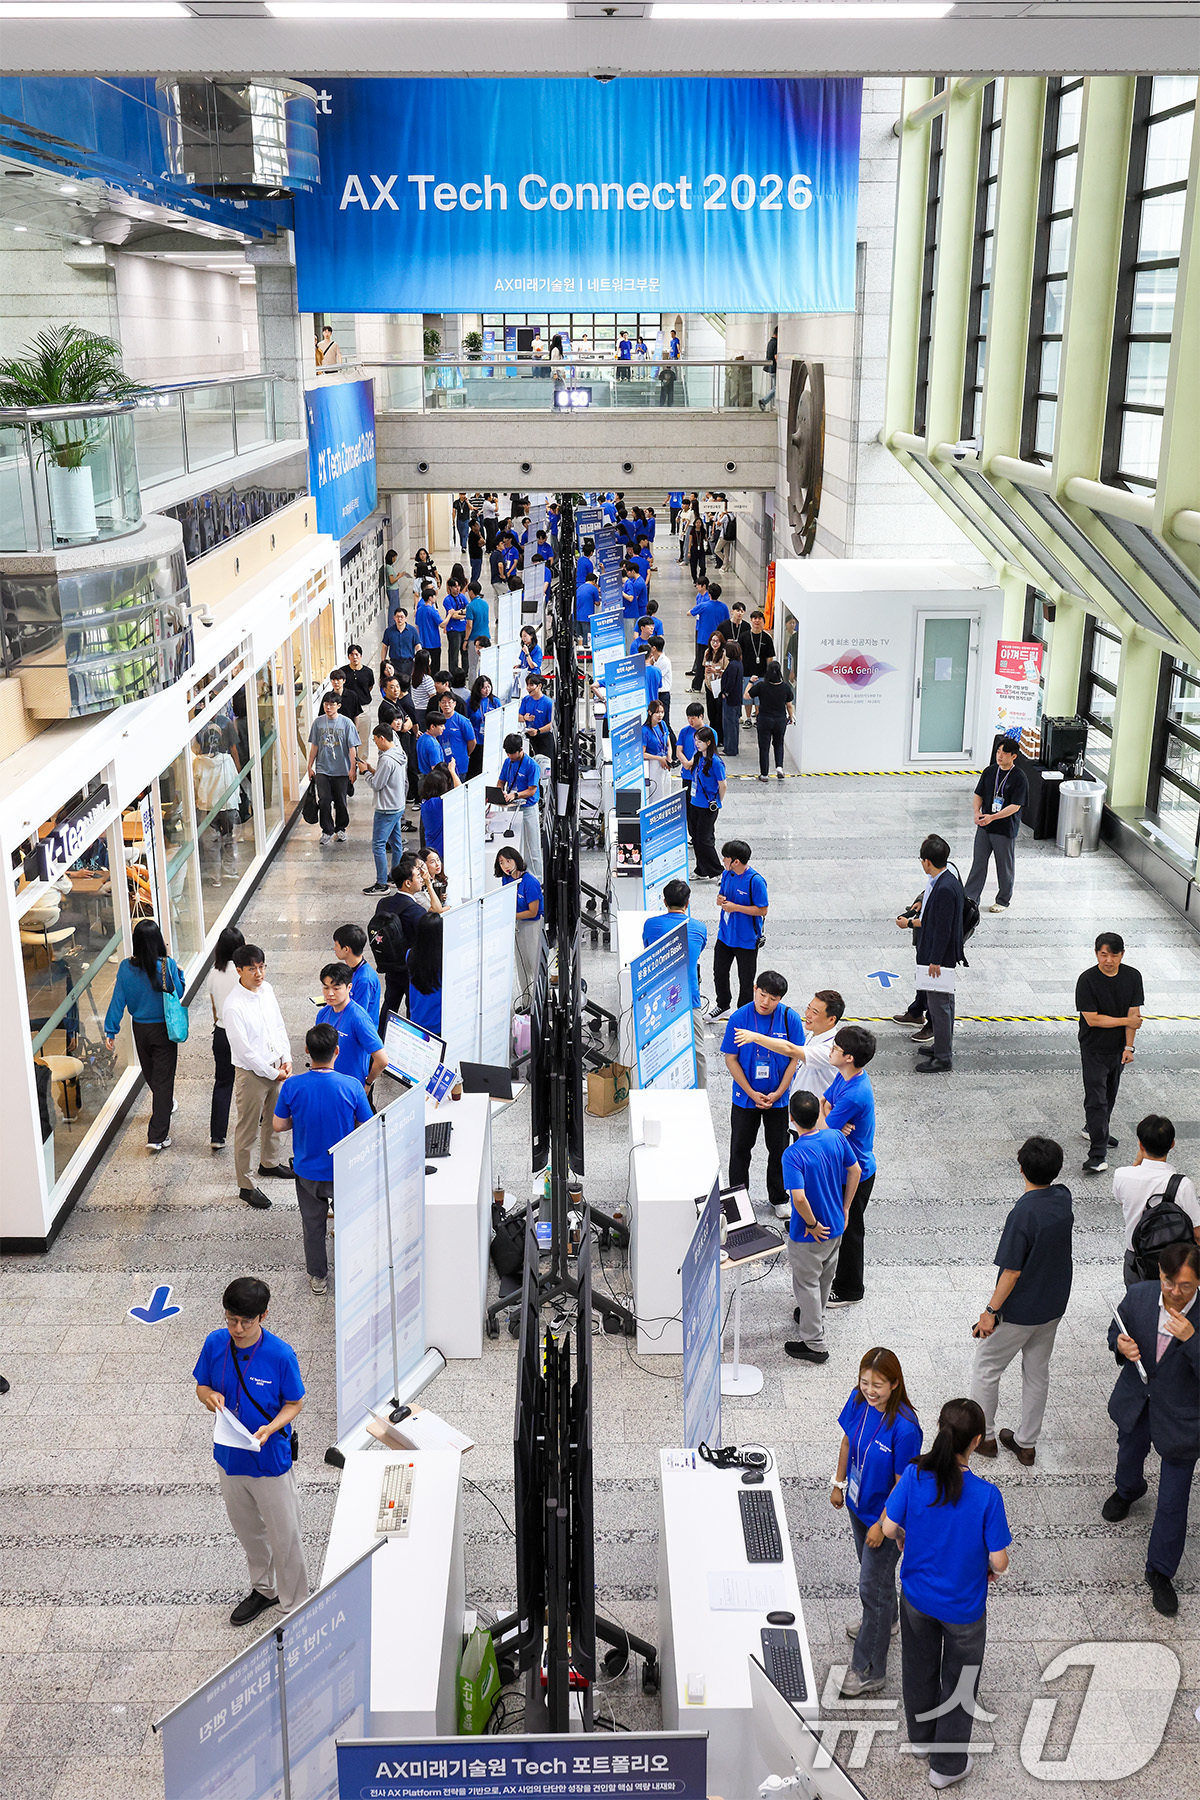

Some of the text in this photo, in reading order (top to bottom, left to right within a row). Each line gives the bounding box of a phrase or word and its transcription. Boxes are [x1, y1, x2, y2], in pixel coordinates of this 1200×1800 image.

[315, 89, 332, 115] t
[339, 174, 813, 211] AX Tech Connect 2026
[494, 278, 661, 292] AX미래기술원 네트워크부문
[327, 443, 342, 481] Tech
[851, 638, 878, 646] 인공지능
[832, 666, 879, 675] GiGA Genie
[659, 951, 670, 965] Omni
[670, 942, 682, 957] Basic
[375, 1754, 669, 1779] AX미래기술원 Tech 포트폴리오
[370, 1780, 676, 1797] 전사 AX Platform 전략을 기반으로, AX 사업의 단단한 성장을 견인할 핵심 역량 내재화
